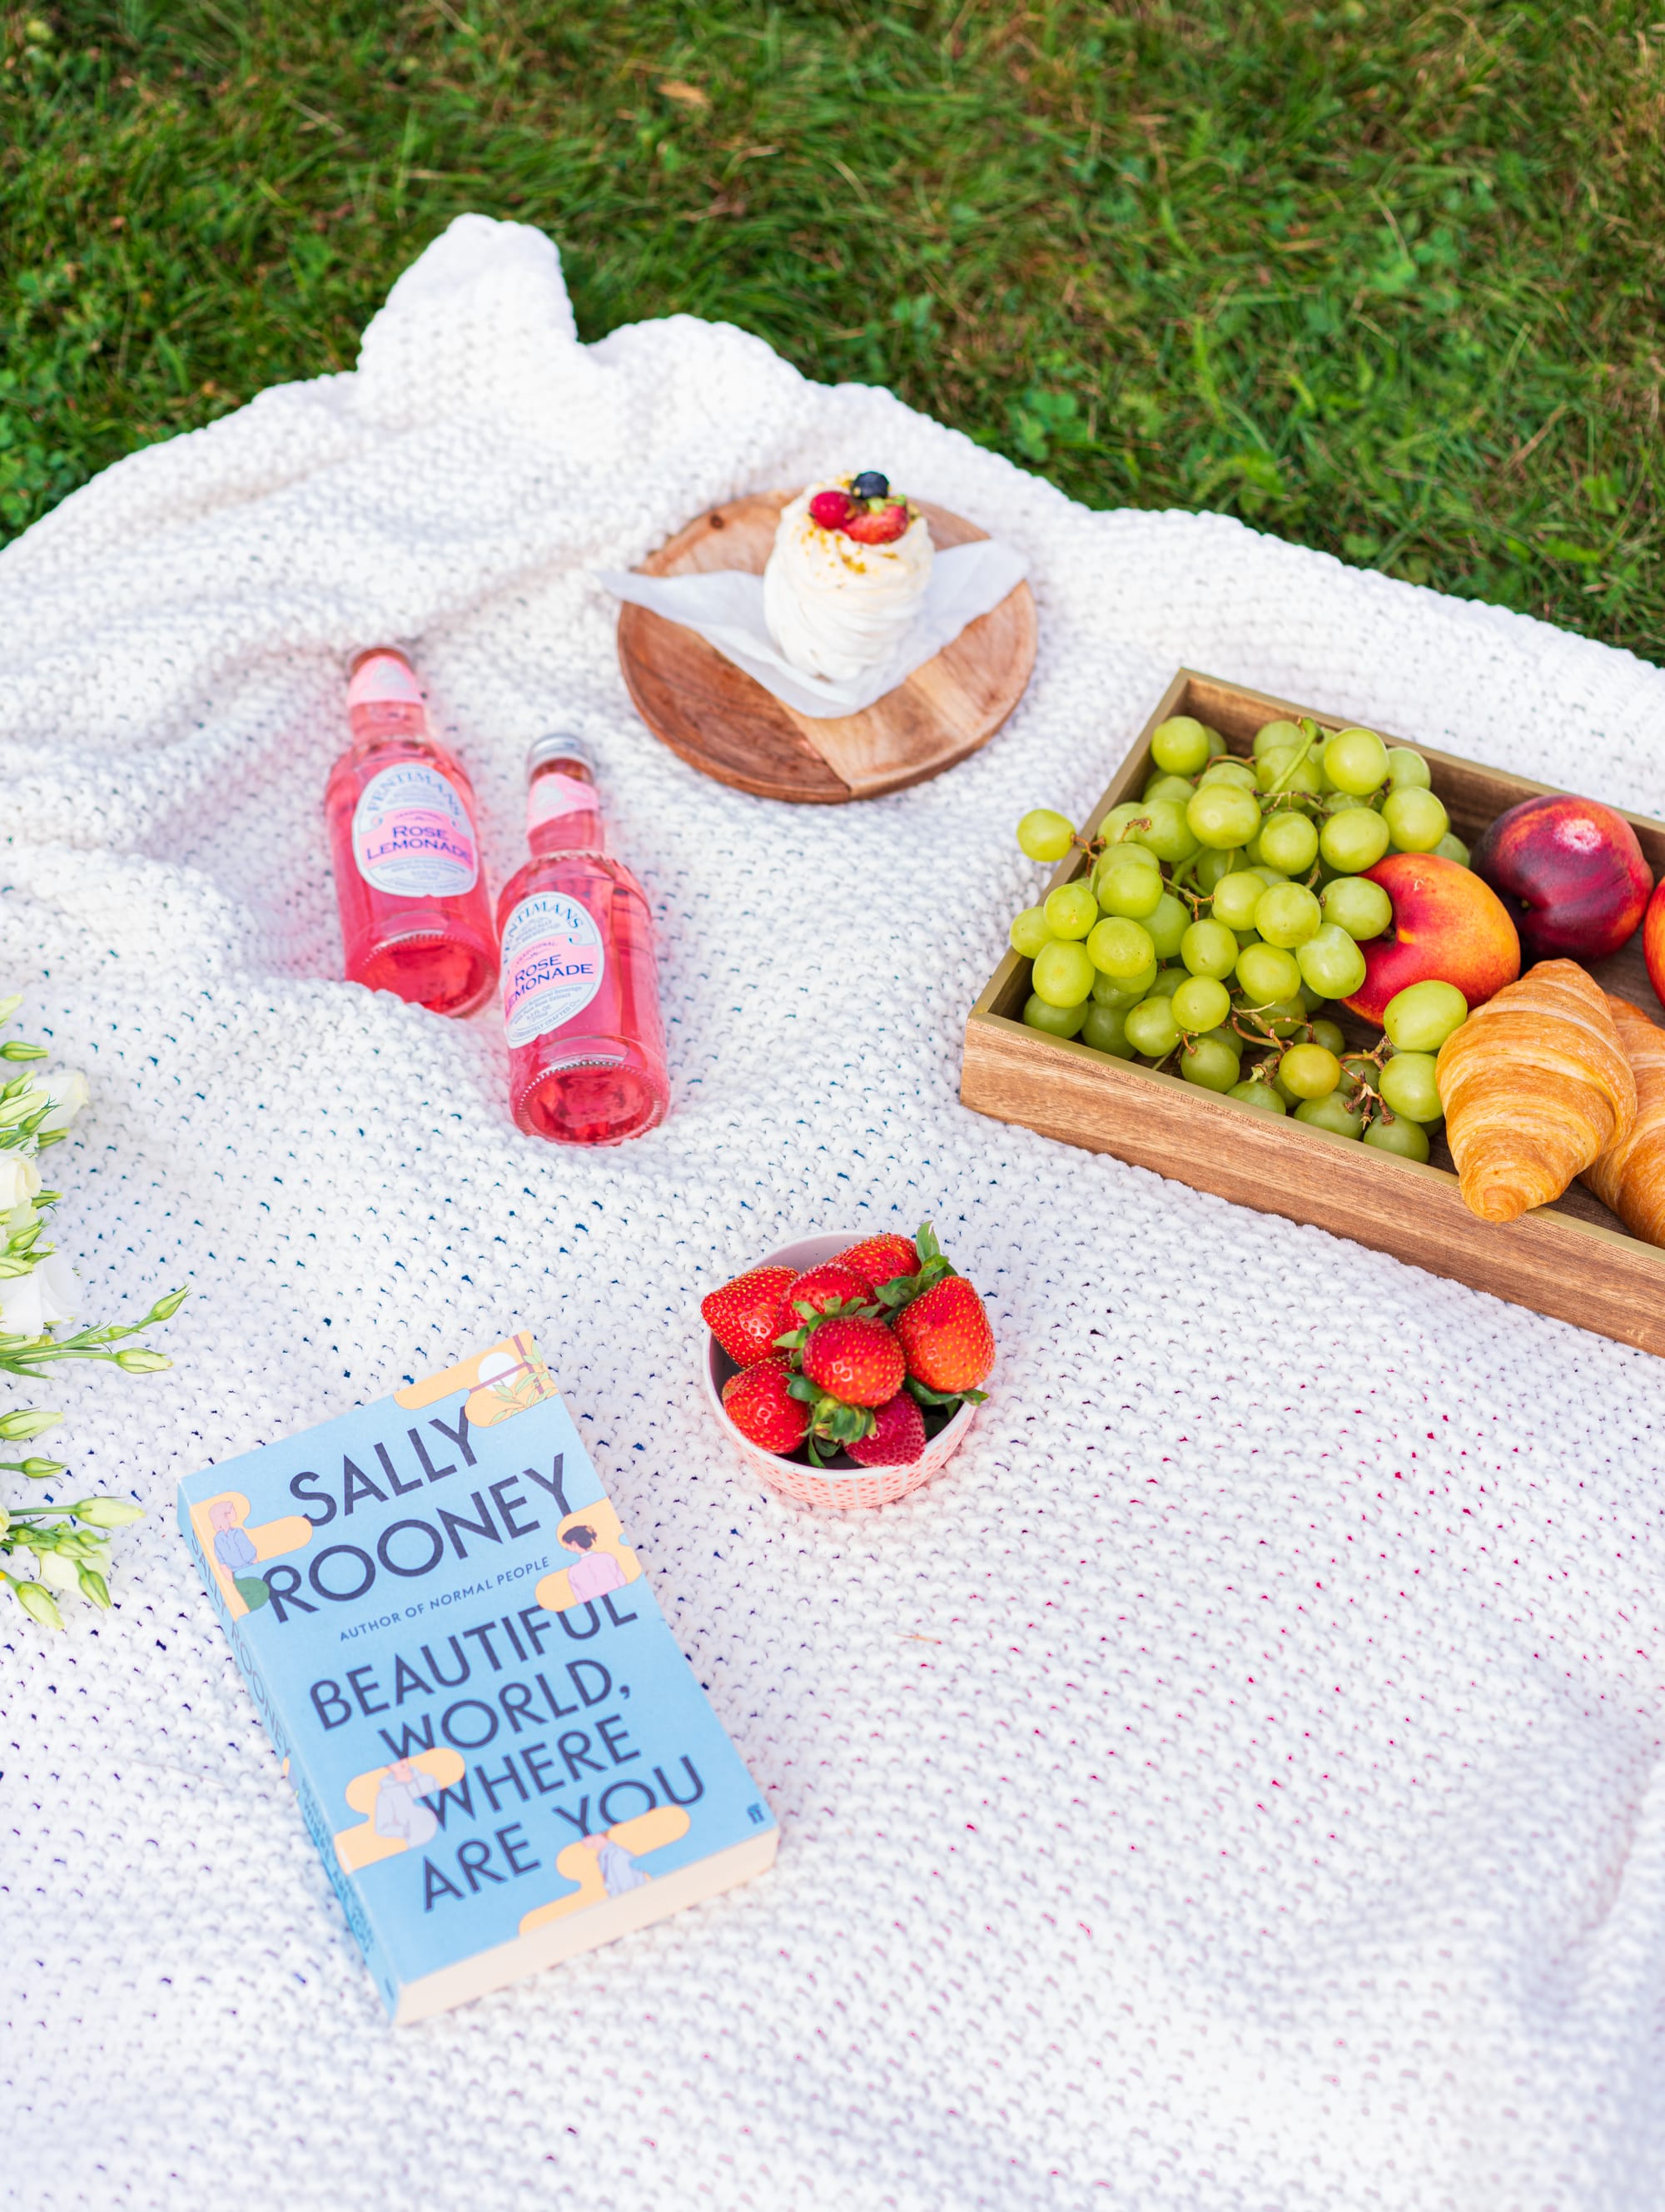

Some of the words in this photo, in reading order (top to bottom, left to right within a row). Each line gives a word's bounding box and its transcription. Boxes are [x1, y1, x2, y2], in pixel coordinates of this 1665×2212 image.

[393, 825, 449, 841] ROSE
[514, 953, 562, 987] ROSE
[289, 1405, 478, 1527] SALLY
[262, 1452, 573, 1623] ROONEY
[340, 1613, 401, 1643] AUTHOR
[405, 1603, 425, 1618] OF
[430, 1579, 493, 1610] NORMAL
[496, 1556, 550, 1586] PEOPLE
[309, 1593, 639, 1732] BEAUTIFUL
[378, 1658, 631, 1761] WORLD,
[420, 1713, 642, 1832] WHERE
[423, 1822, 542, 1912] ARE
[552, 1753, 706, 1837] YOU
